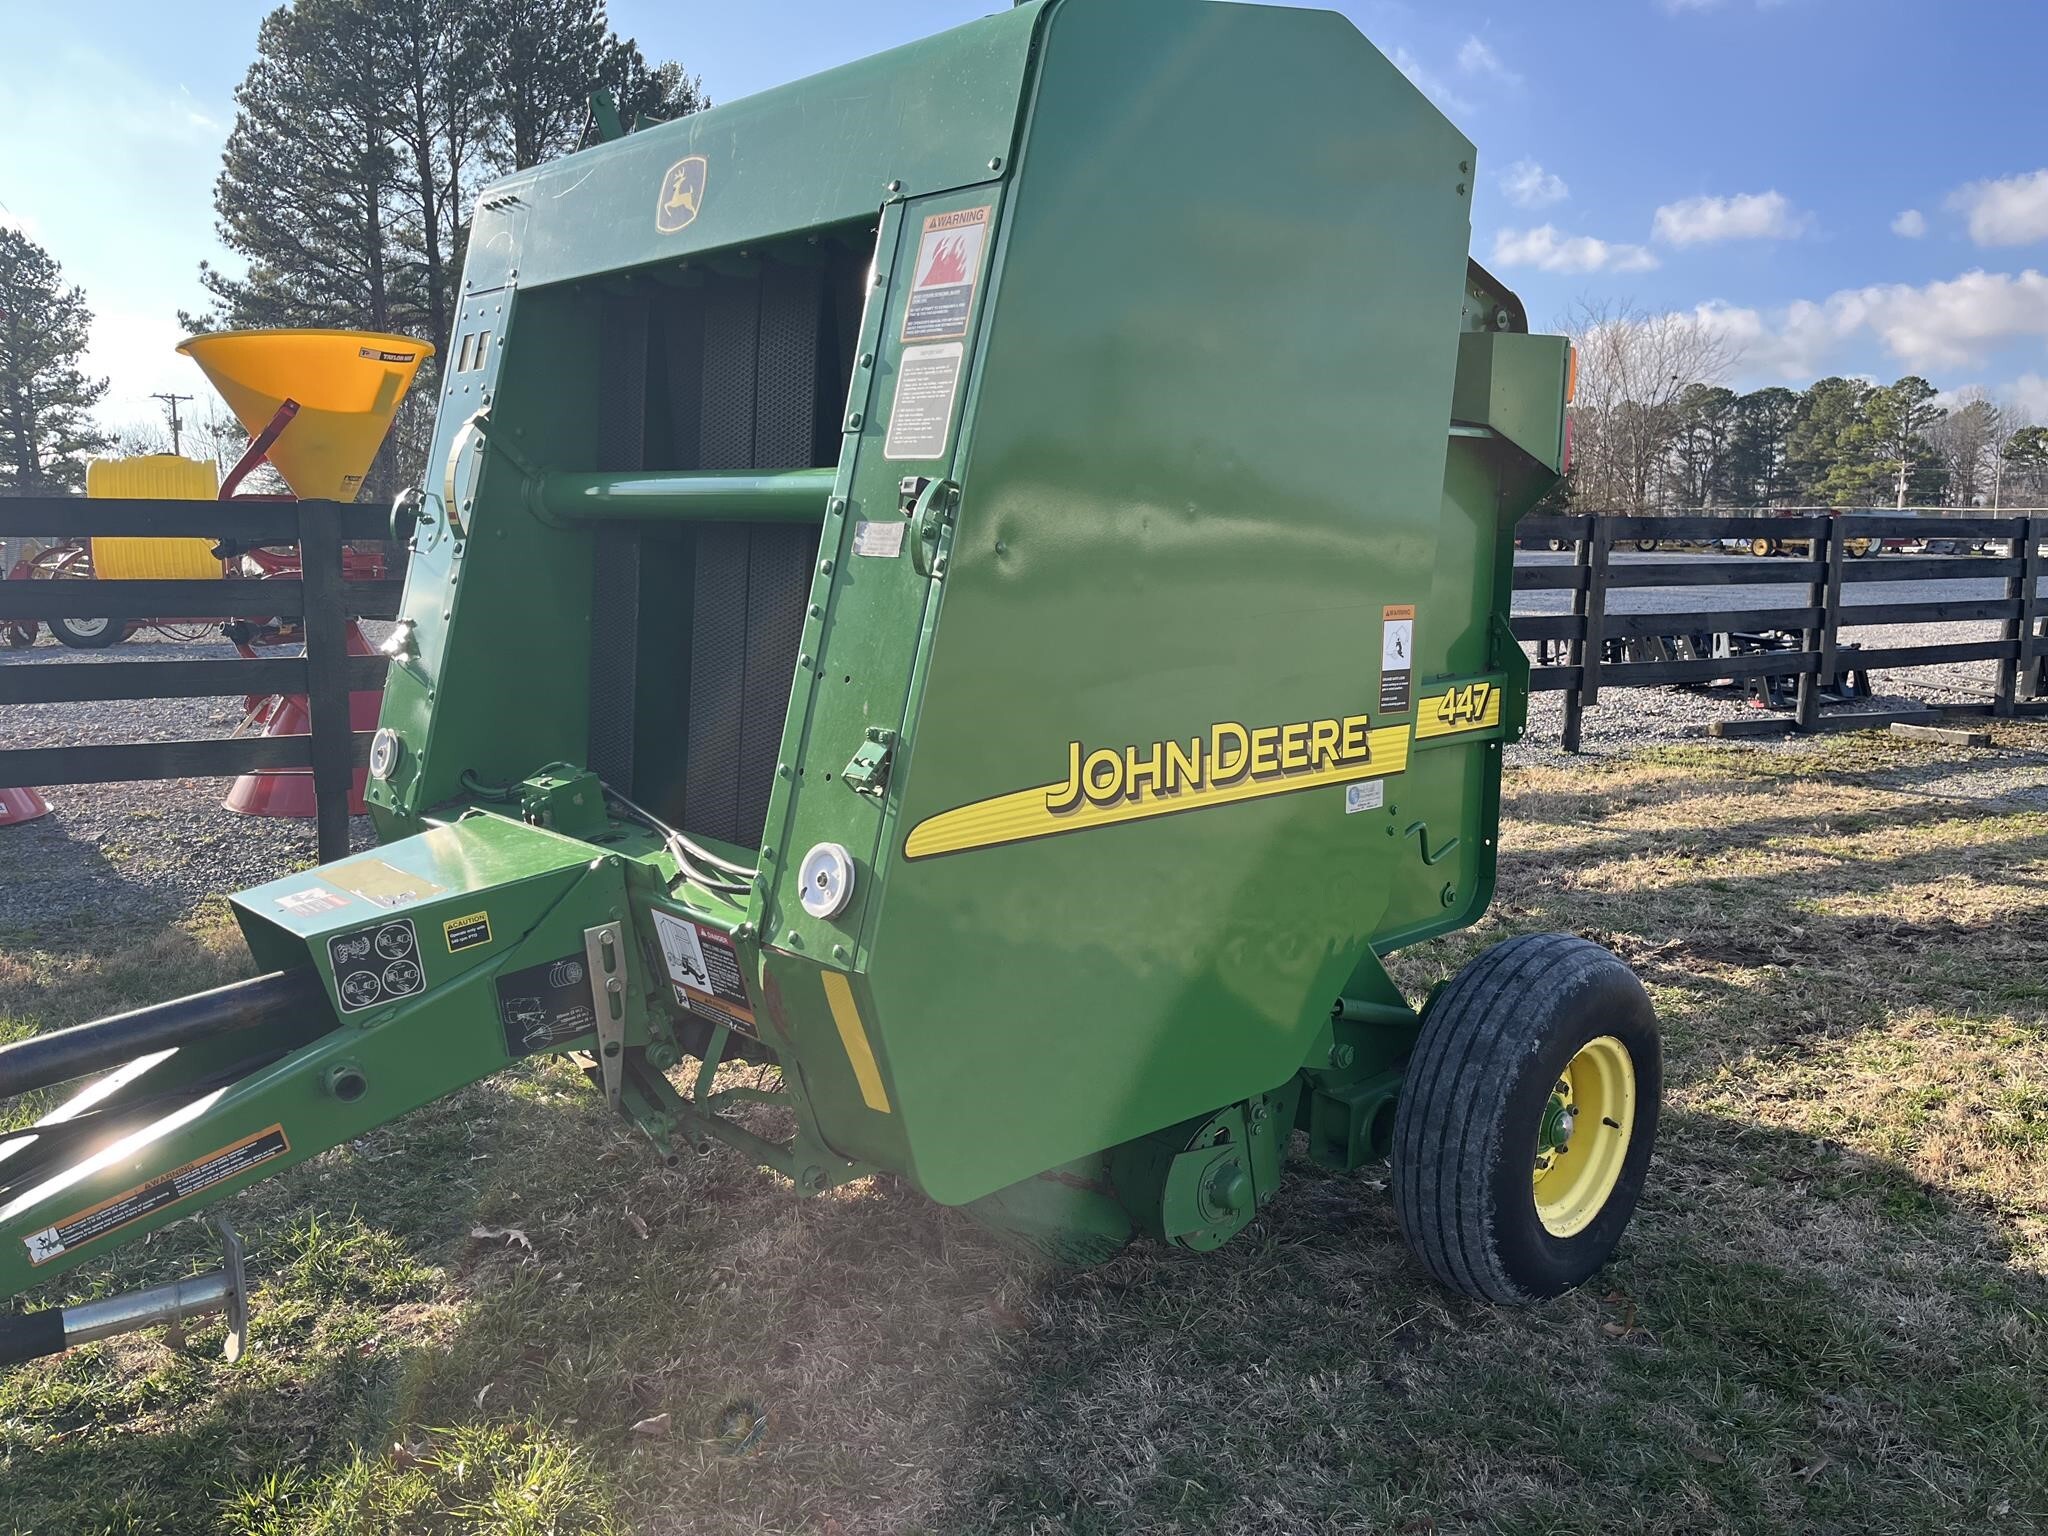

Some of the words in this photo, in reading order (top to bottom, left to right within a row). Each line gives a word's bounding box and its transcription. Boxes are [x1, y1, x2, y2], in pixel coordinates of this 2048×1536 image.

[937, 209, 984, 227] WARNING
[1438, 682, 1490, 725] 447
[1046, 736, 1204, 814] JOHN
[1210, 713, 1370, 787] DEERE
[453, 915, 485, 927] CAUTION
